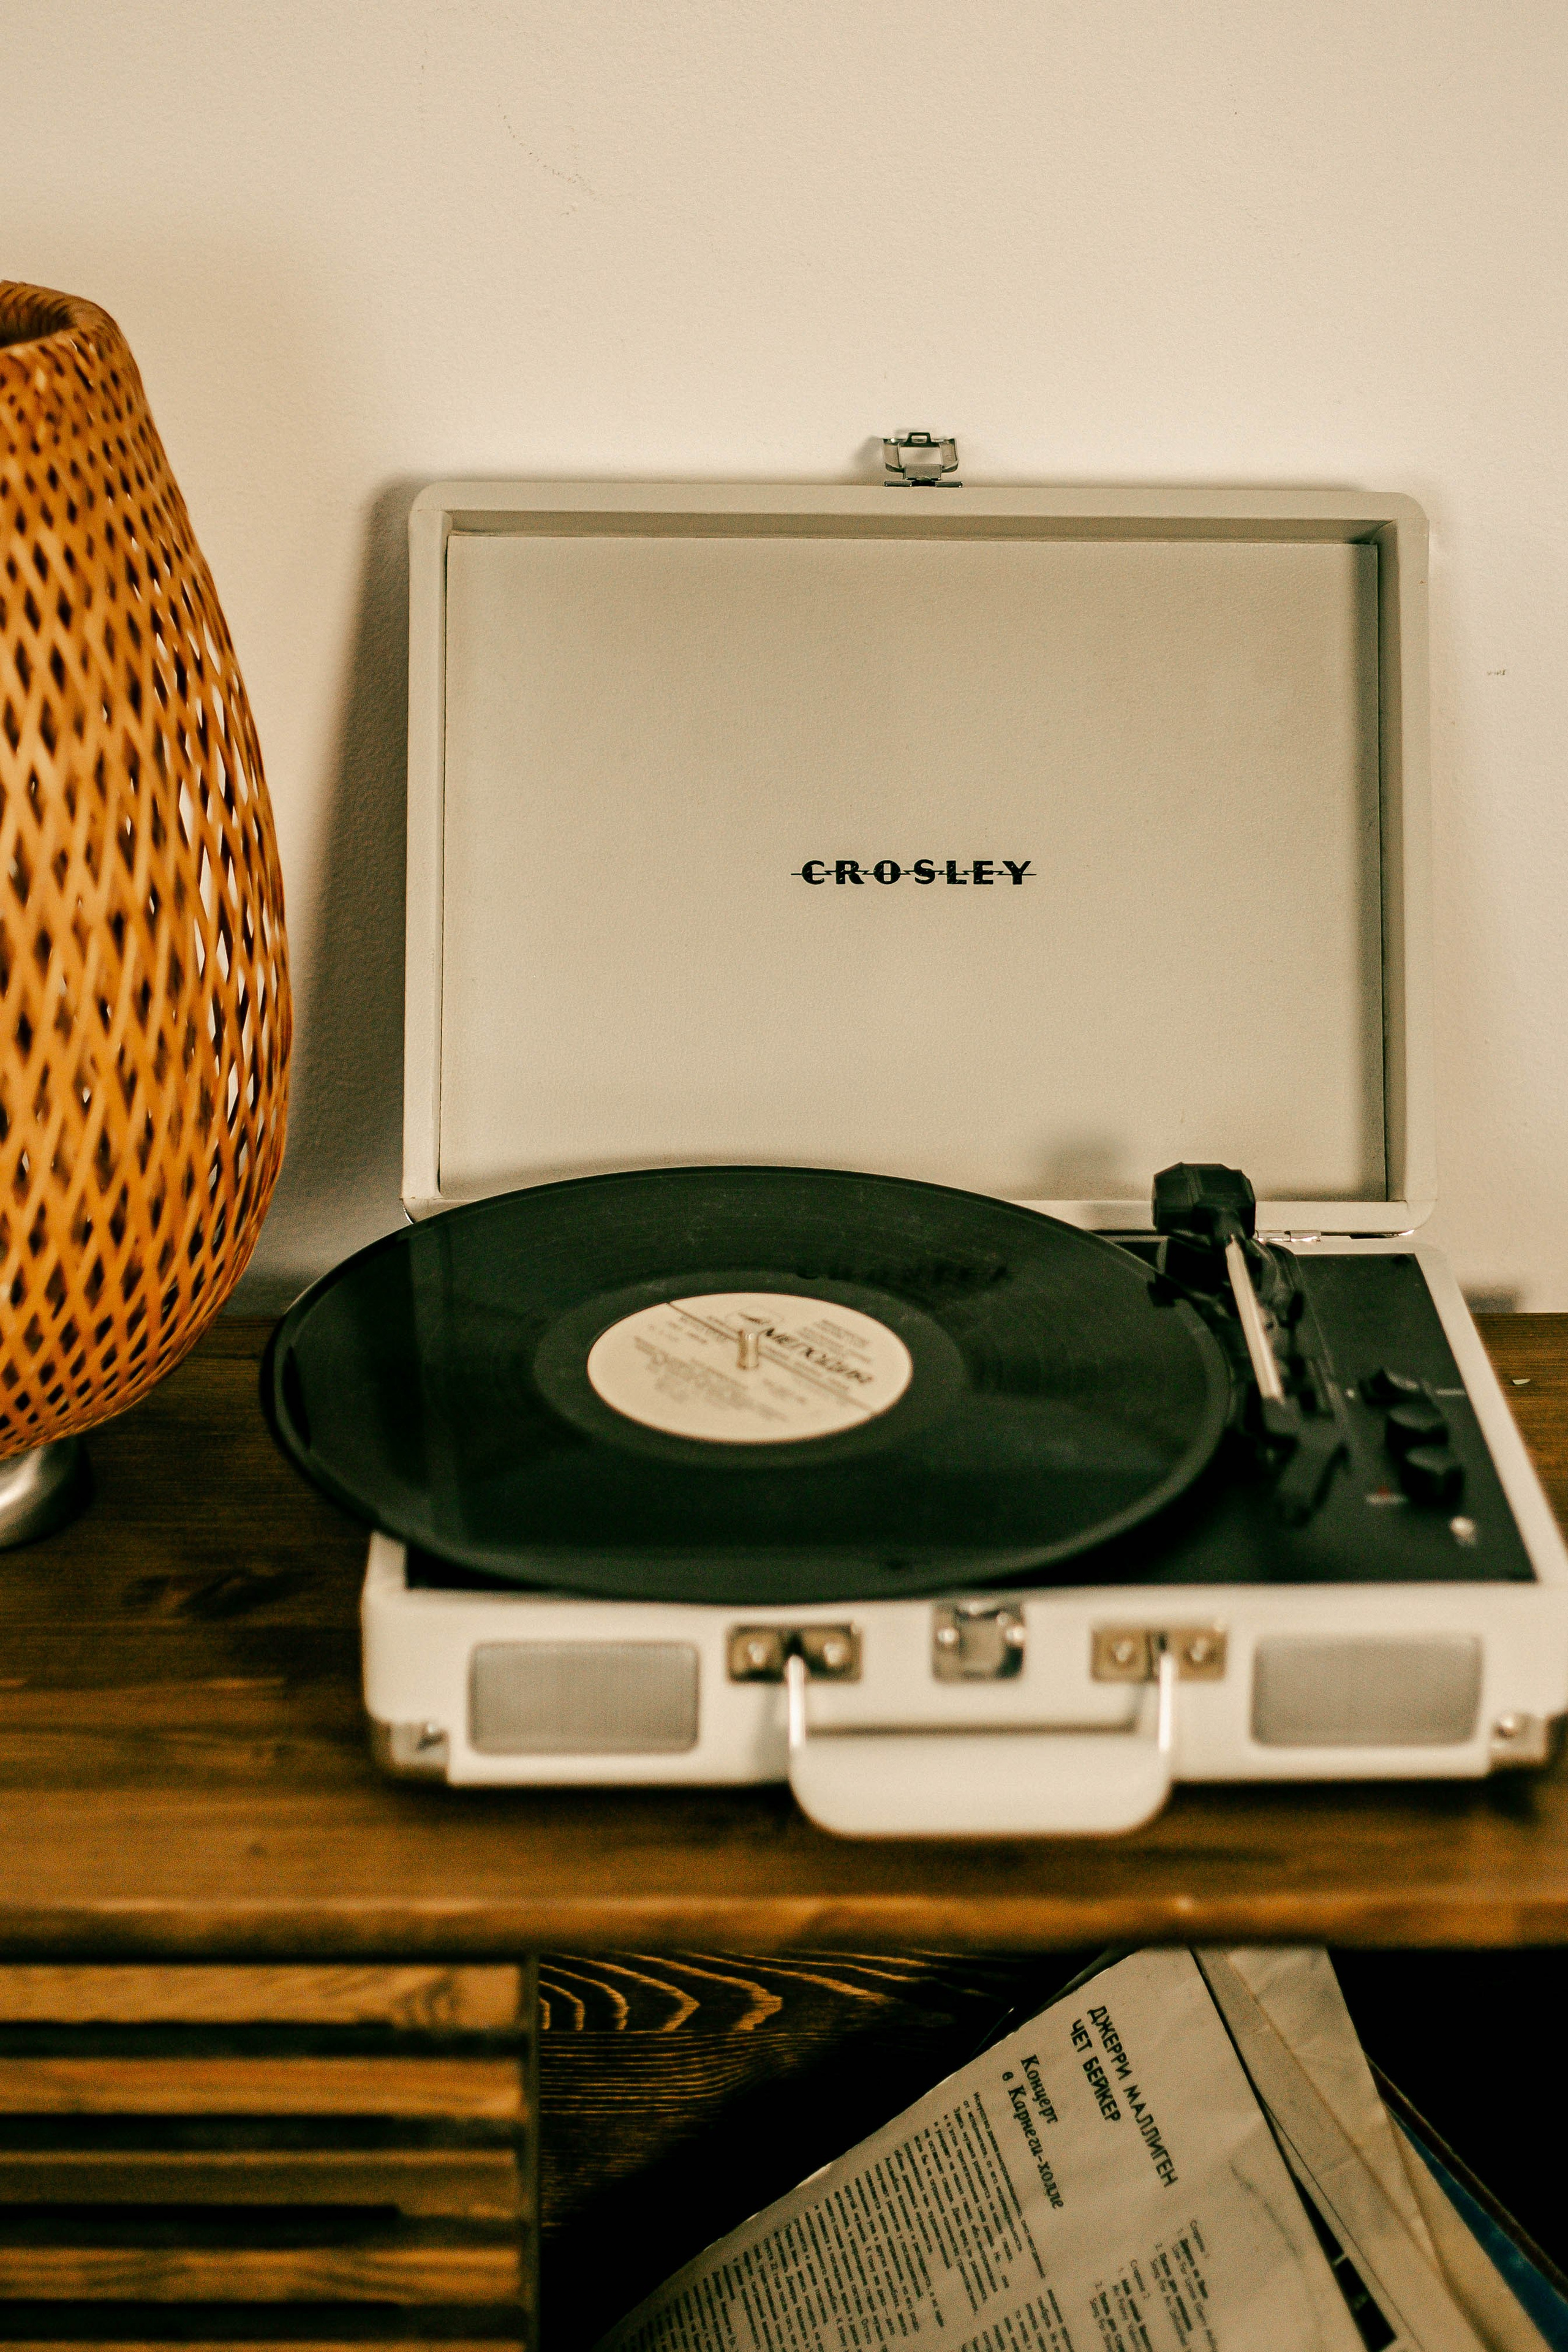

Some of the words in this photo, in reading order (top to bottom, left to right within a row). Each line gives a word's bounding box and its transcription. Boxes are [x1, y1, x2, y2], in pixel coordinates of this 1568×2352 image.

[801, 859, 1032, 885] CROSLEY
[1001, 2070, 1014, 2082] в
[1019, 2053, 1058, 2124] Концерт
[1069, 2018, 1093, 2053] ЧЕТ
[1082, 2055, 1121, 2122] БЕЙКЕР
[1086, 2005, 1133, 2081] ДЖЕРРИ
[1122, 2084, 1178, 2188] МАЛЛИГЕН
[1006, 2084, 1064, 2209] Карнеги-холле
